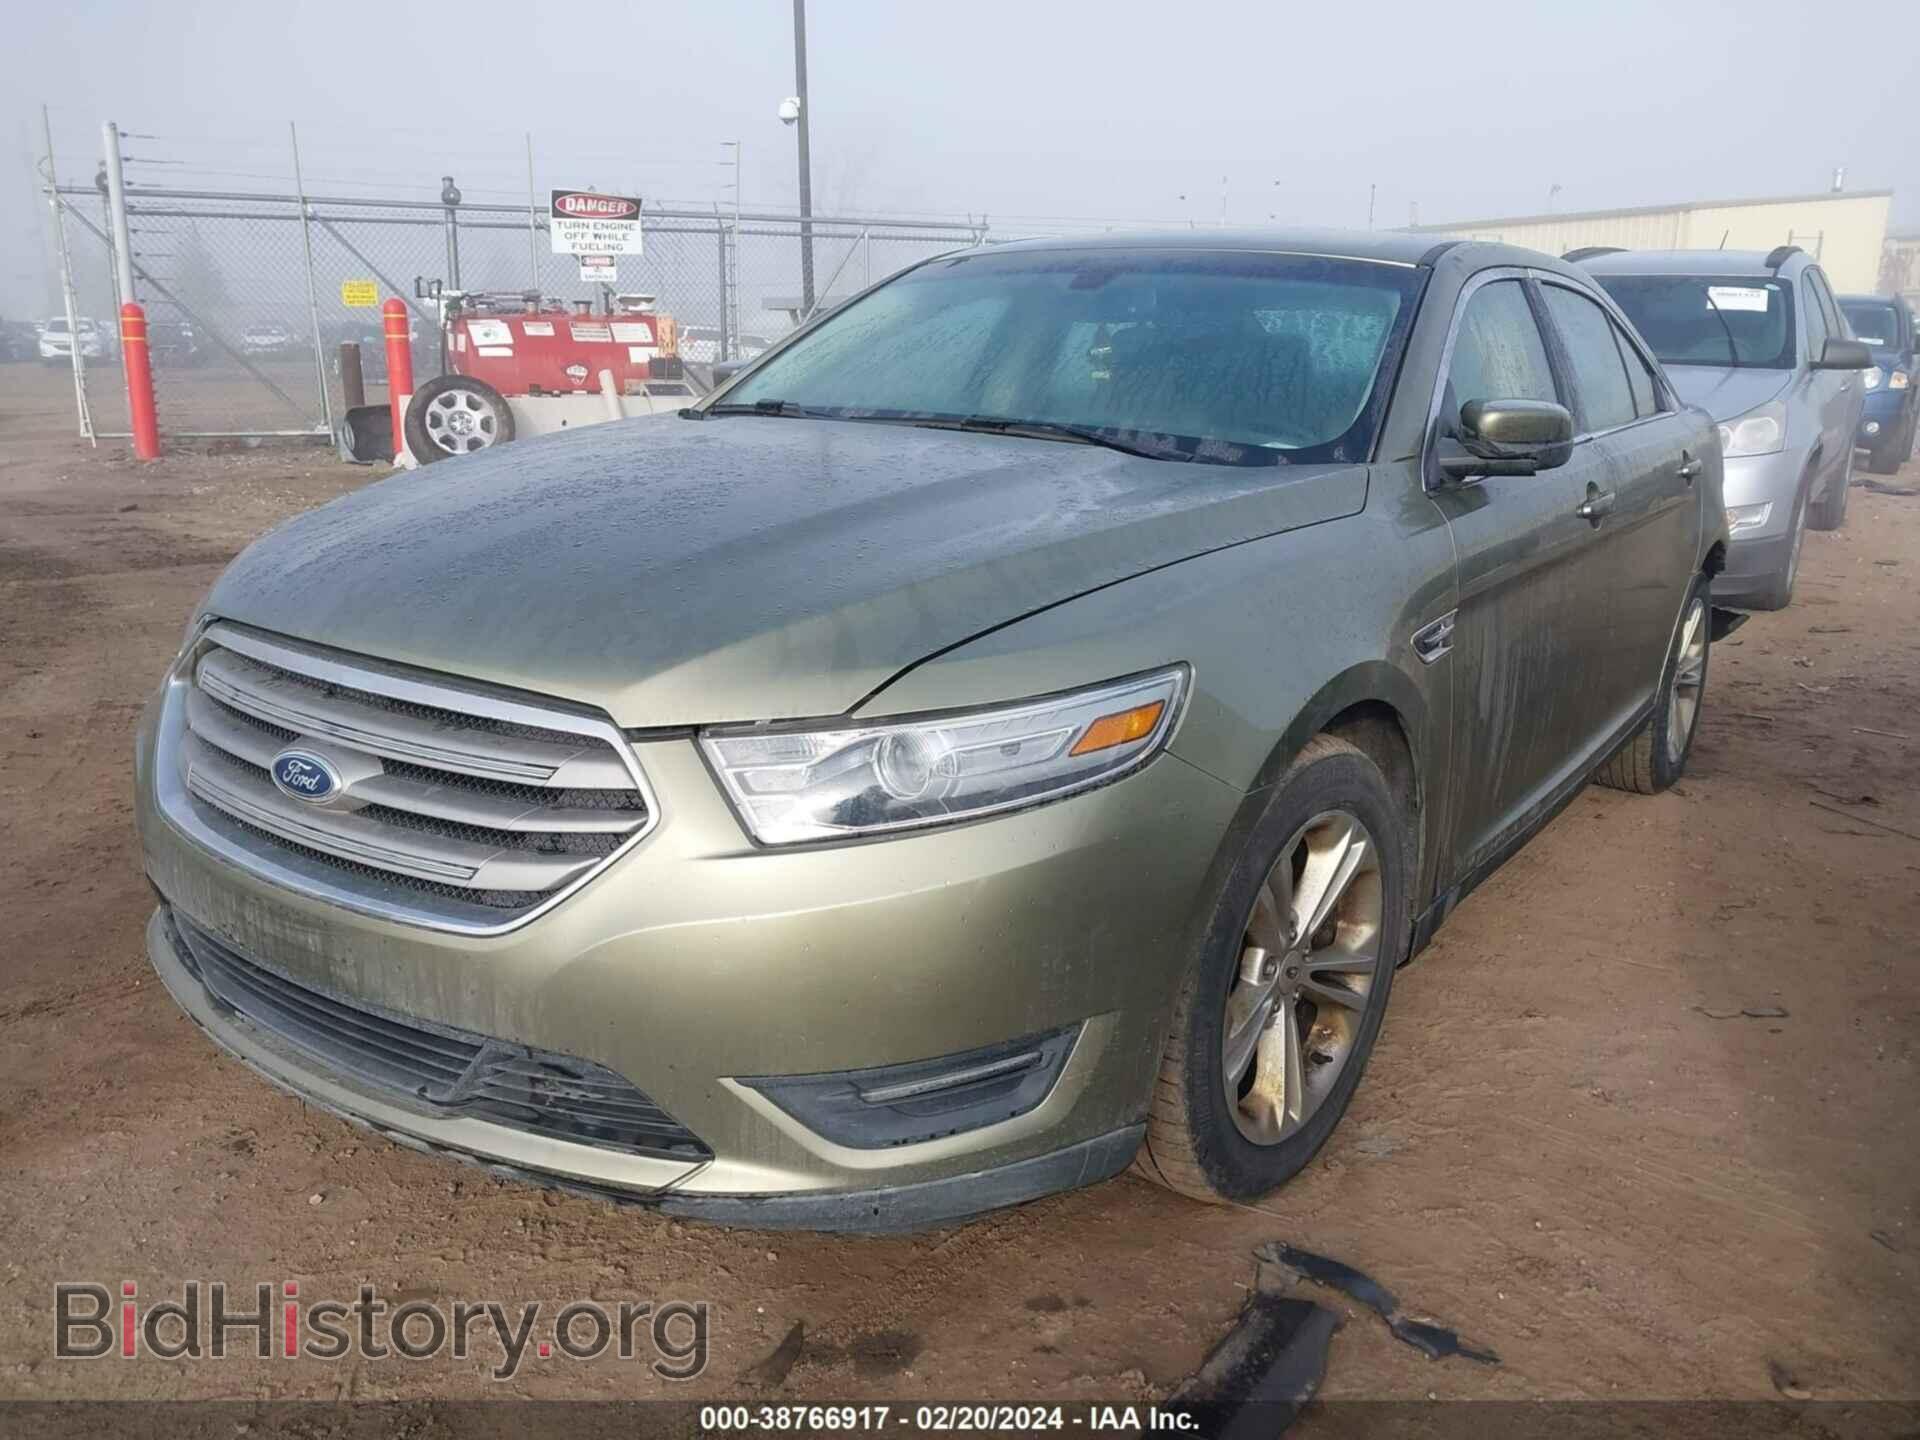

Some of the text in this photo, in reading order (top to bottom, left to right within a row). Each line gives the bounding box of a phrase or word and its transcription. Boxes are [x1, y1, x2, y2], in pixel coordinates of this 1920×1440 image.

[565, 198, 627, 213] DANGER
[557, 221, 635, 231] TURN ENGINE
[564, 232, 630, 241] OFF WHILE
[571, 242, 624, 251] FUELING
[282, 760, 320, 791] Ford
